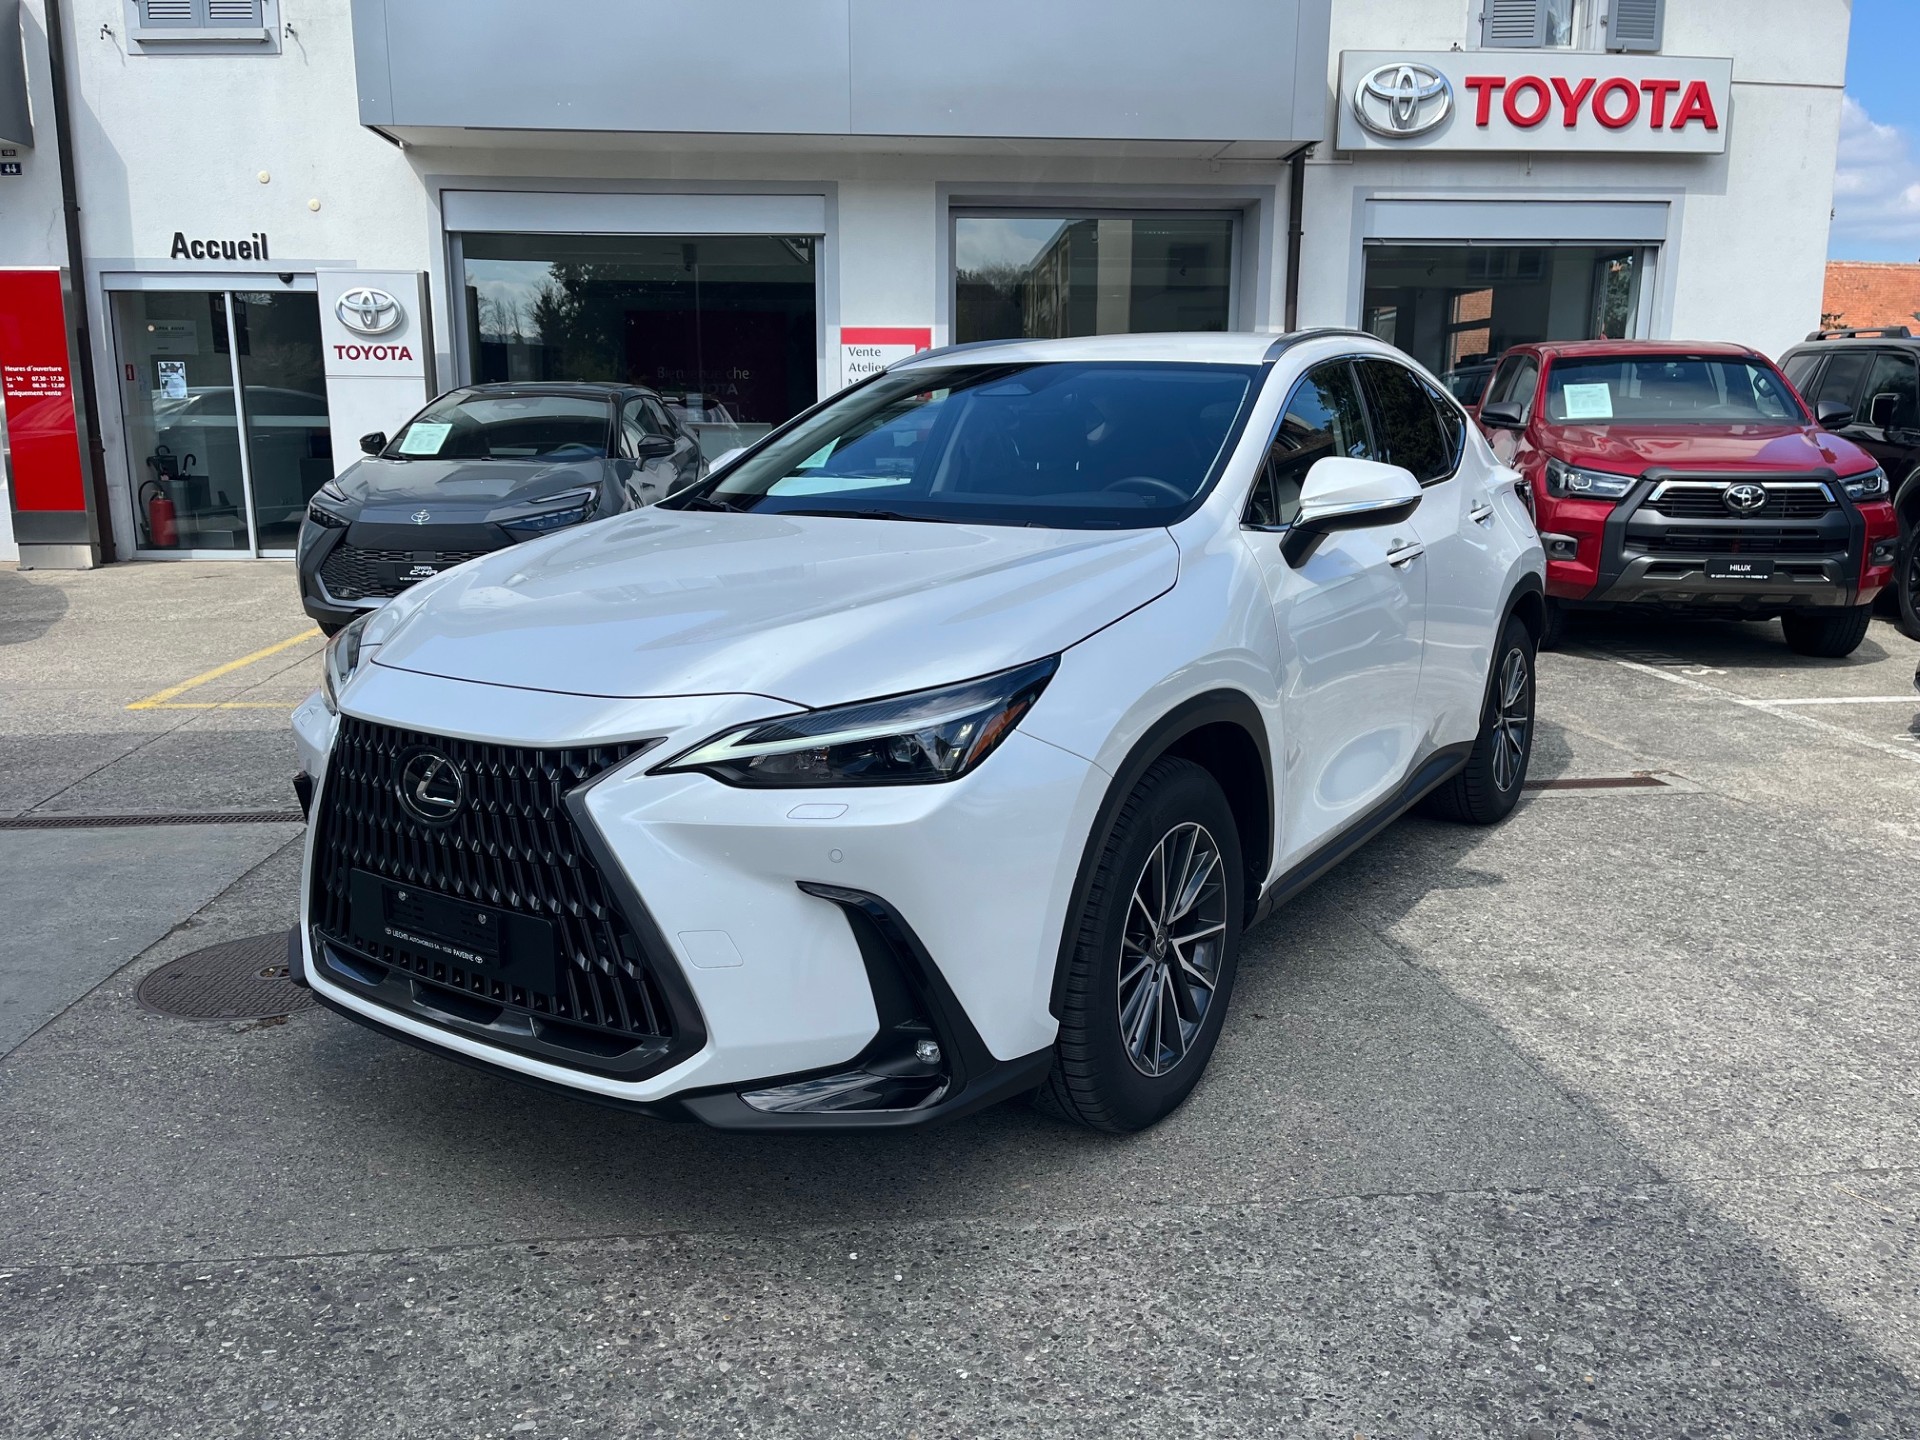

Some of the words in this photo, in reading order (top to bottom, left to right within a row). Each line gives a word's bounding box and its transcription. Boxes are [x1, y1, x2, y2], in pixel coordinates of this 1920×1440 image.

[1465, 75, 1718, 129] TOYOTA
[5, 164, 17, 173] 44
[170, 232, 269, 260] Accueil
[334, 345, 413, 361] TOYOTA
[848, 346, 881, 357] Vente
[848, 362, 886, 373] Atelier
